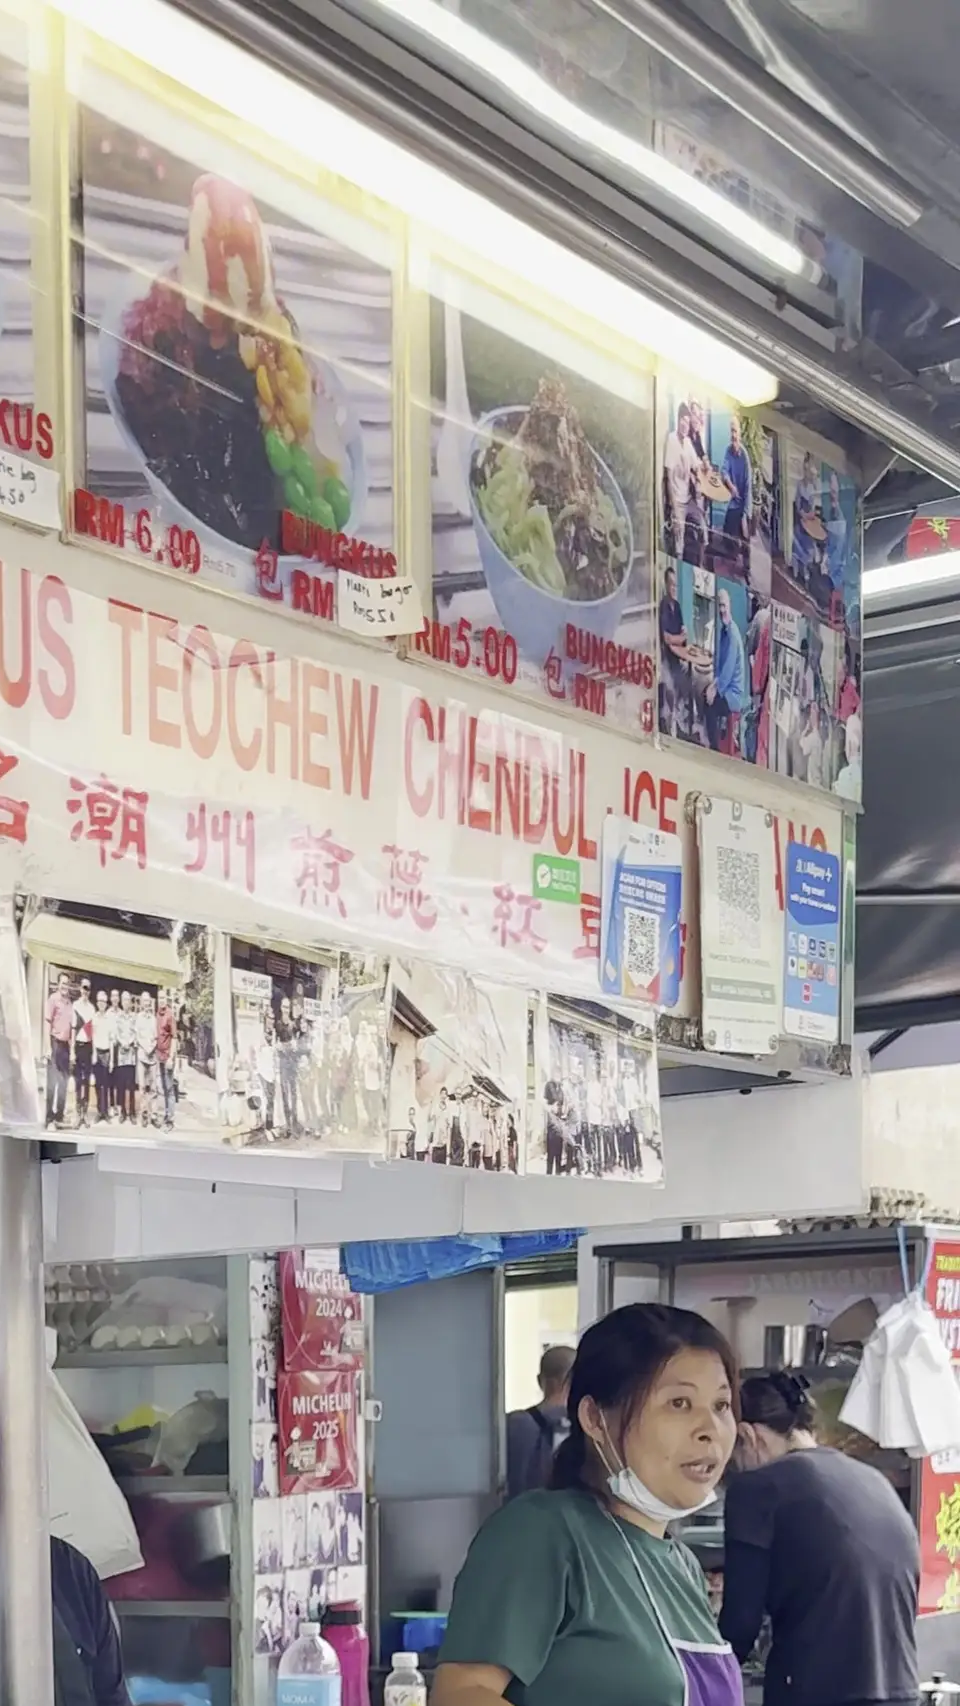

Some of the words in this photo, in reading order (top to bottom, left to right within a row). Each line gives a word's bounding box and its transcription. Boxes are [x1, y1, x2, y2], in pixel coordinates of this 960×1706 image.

[75, 488, 124, 548] RM
[282, 510, 397, 579] BUNGKUS
[292, 569, 334, 621] RM
[543, 646, 565, 699] 包
[565, 622, 653, 689] BUNGKUS
[575, 673, 606, 717] RM
[108, 597, 379, 799] TEOCHEW
[404, 698, 597, 860] CHENDUL
[316, 1298, 342, 1316] 2024
[293, 1392, 352, 1415] MICHELIN
[313, 1420, 339, 1440] 2025
